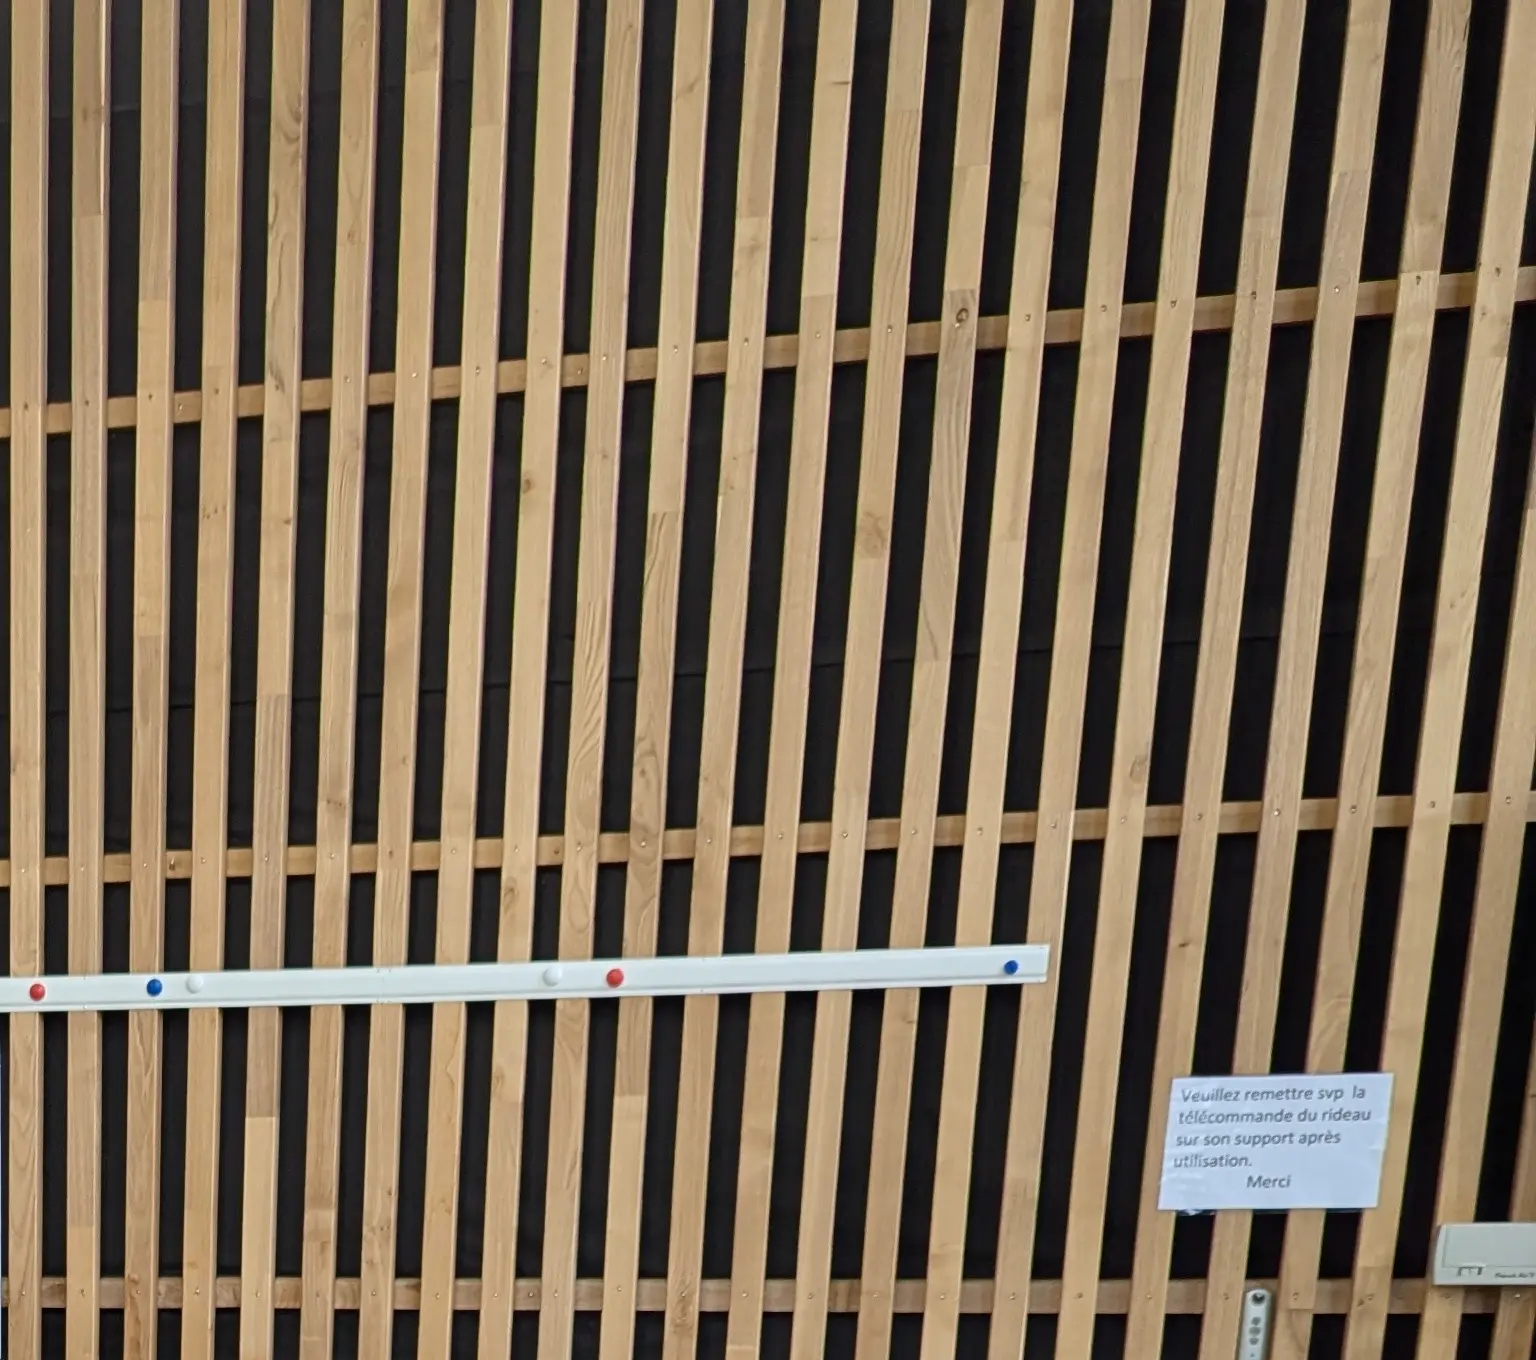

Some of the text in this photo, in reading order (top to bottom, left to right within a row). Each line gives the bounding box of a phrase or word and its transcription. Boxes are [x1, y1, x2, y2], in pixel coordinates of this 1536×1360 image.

[1181, 1085, 1366, 1103] Veuillez remettre svp la
[1179, 1107, 1372, 1125] télécommande du rideau
[1175, 1131, 1342, 1148] sur son support après
[1173, 1154, 1253, 1169] utilisation.
[1246, 1175, 1292, 1189] Merci
